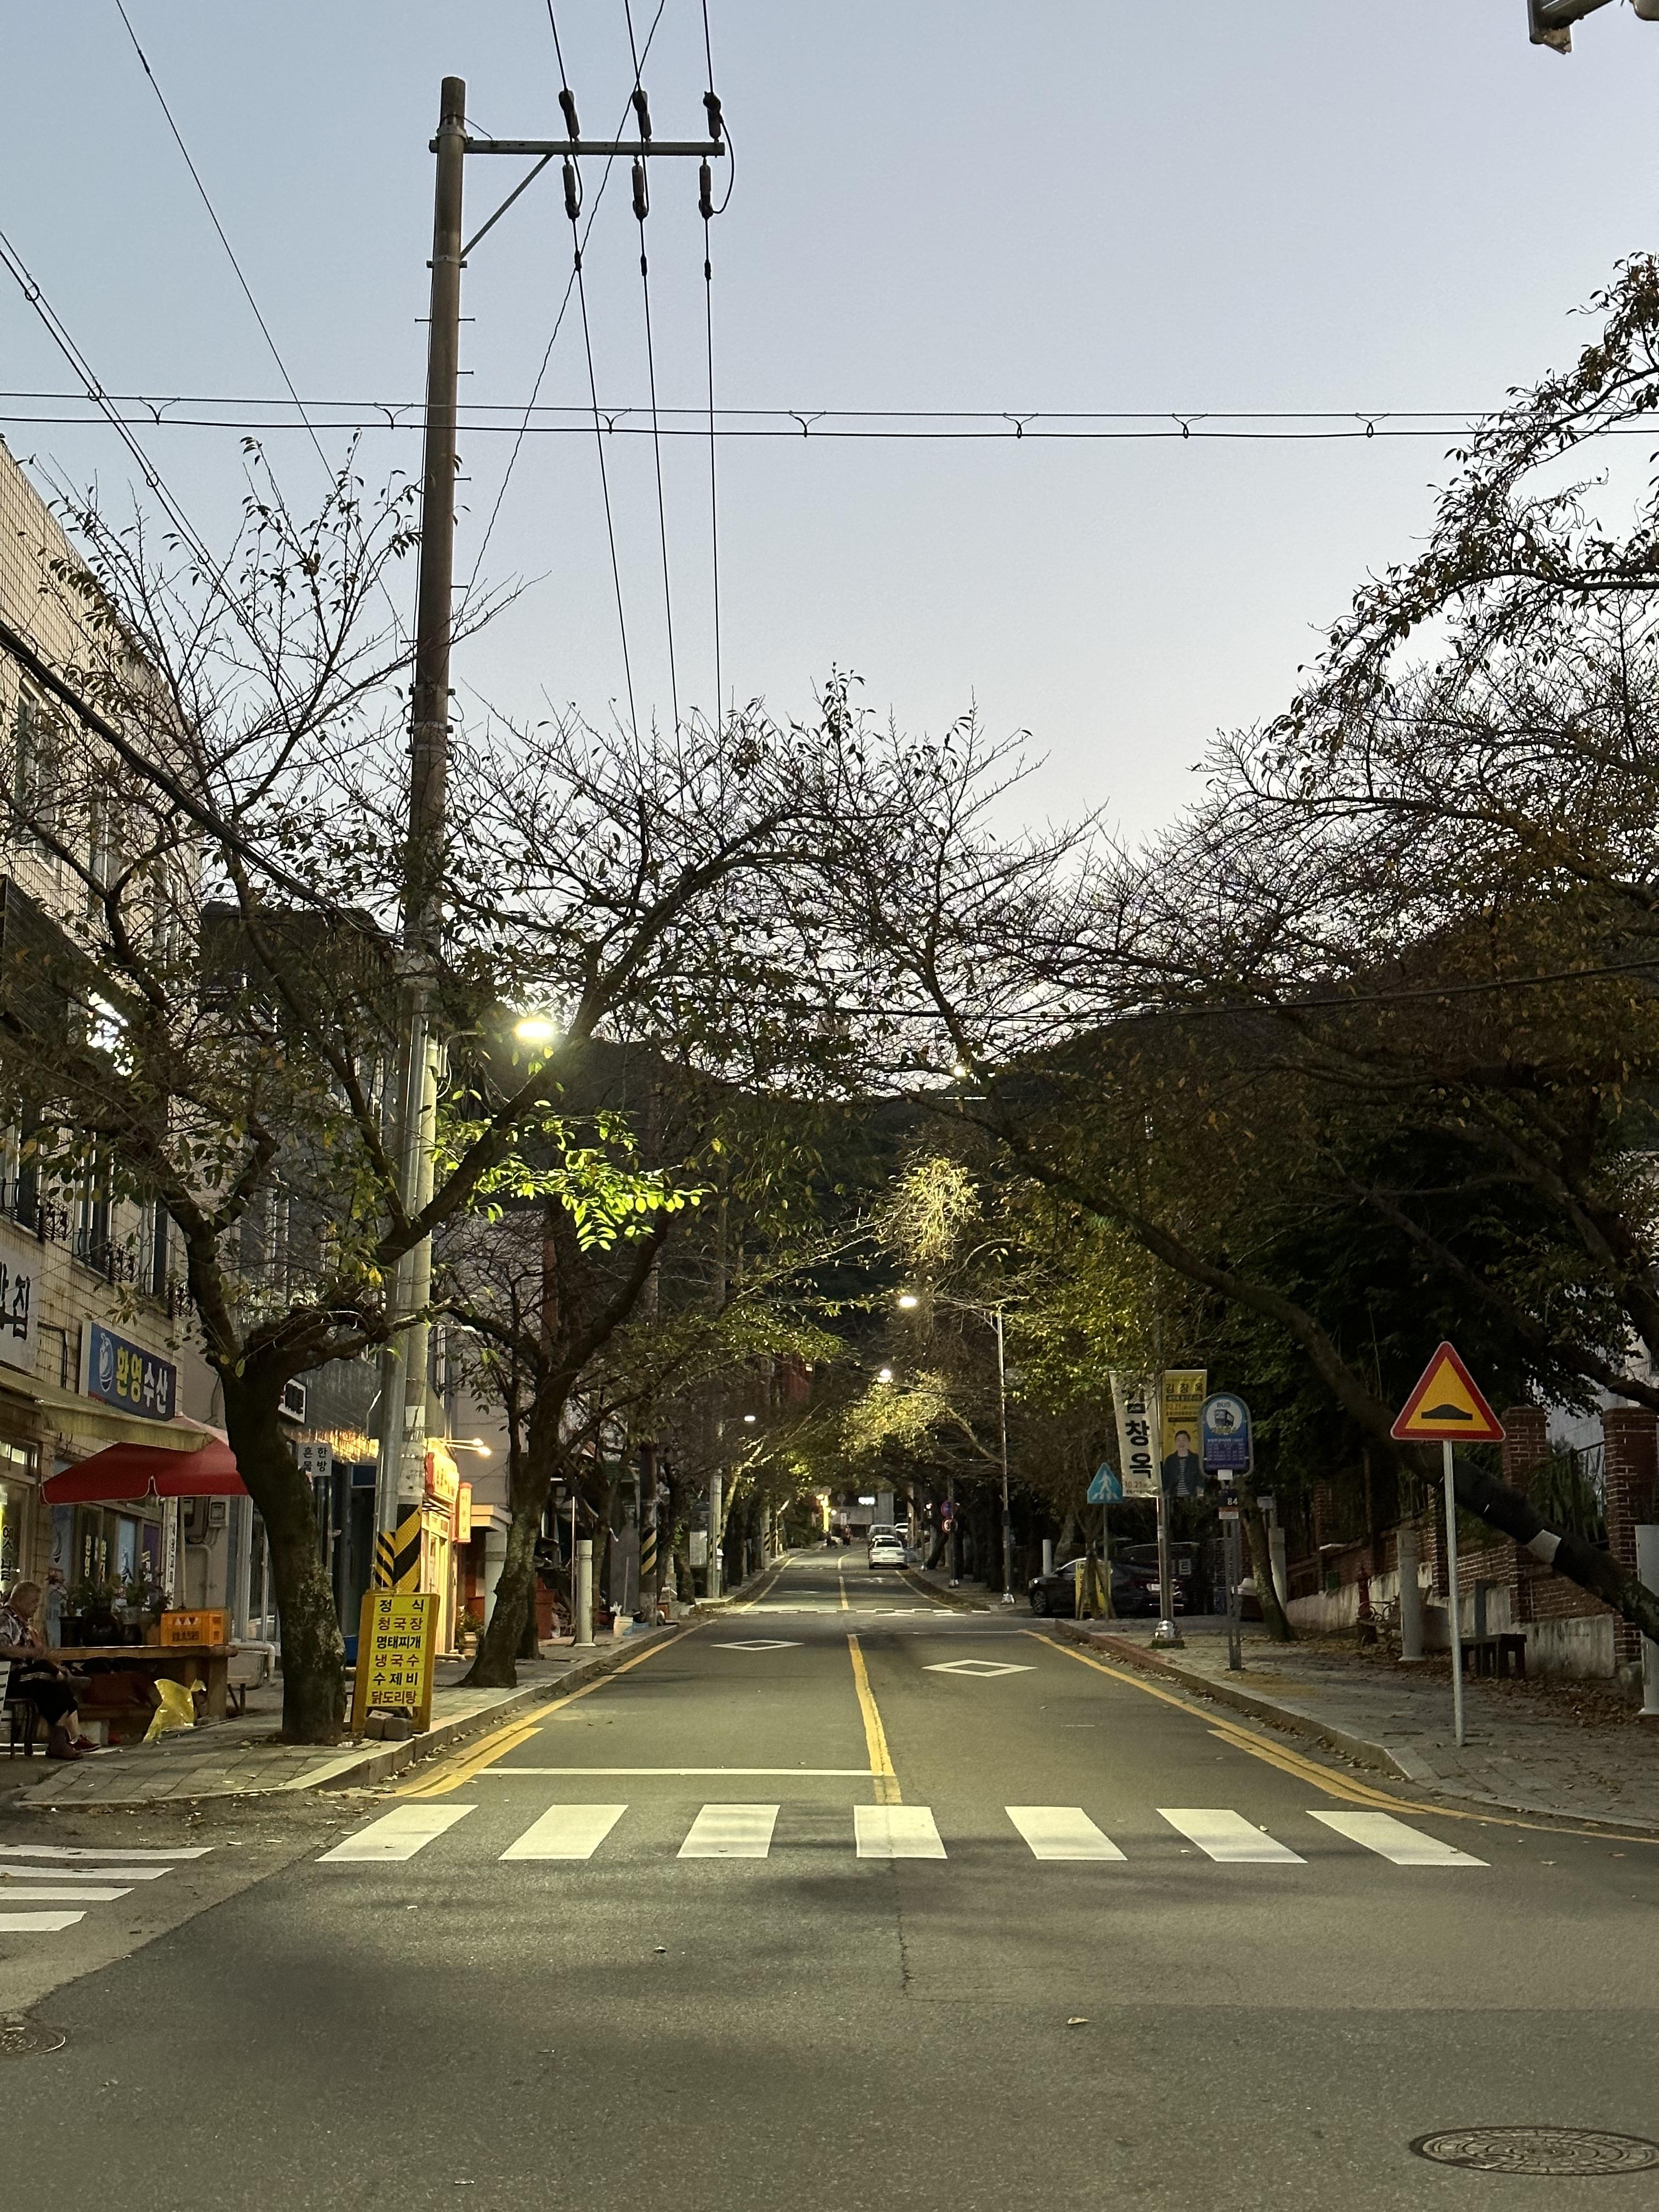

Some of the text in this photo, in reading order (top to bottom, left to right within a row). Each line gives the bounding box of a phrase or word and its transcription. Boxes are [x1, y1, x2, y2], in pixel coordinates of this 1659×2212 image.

[0, 1261, 31, 1340] 집
[116, 1346, 168, 1414] 환영수산
[1227, 1497, 1238, 1505] 84
[376, 1635, 422, 1649] 명태찌개
[371, 1691, 417, 1705] 닭도리탕
